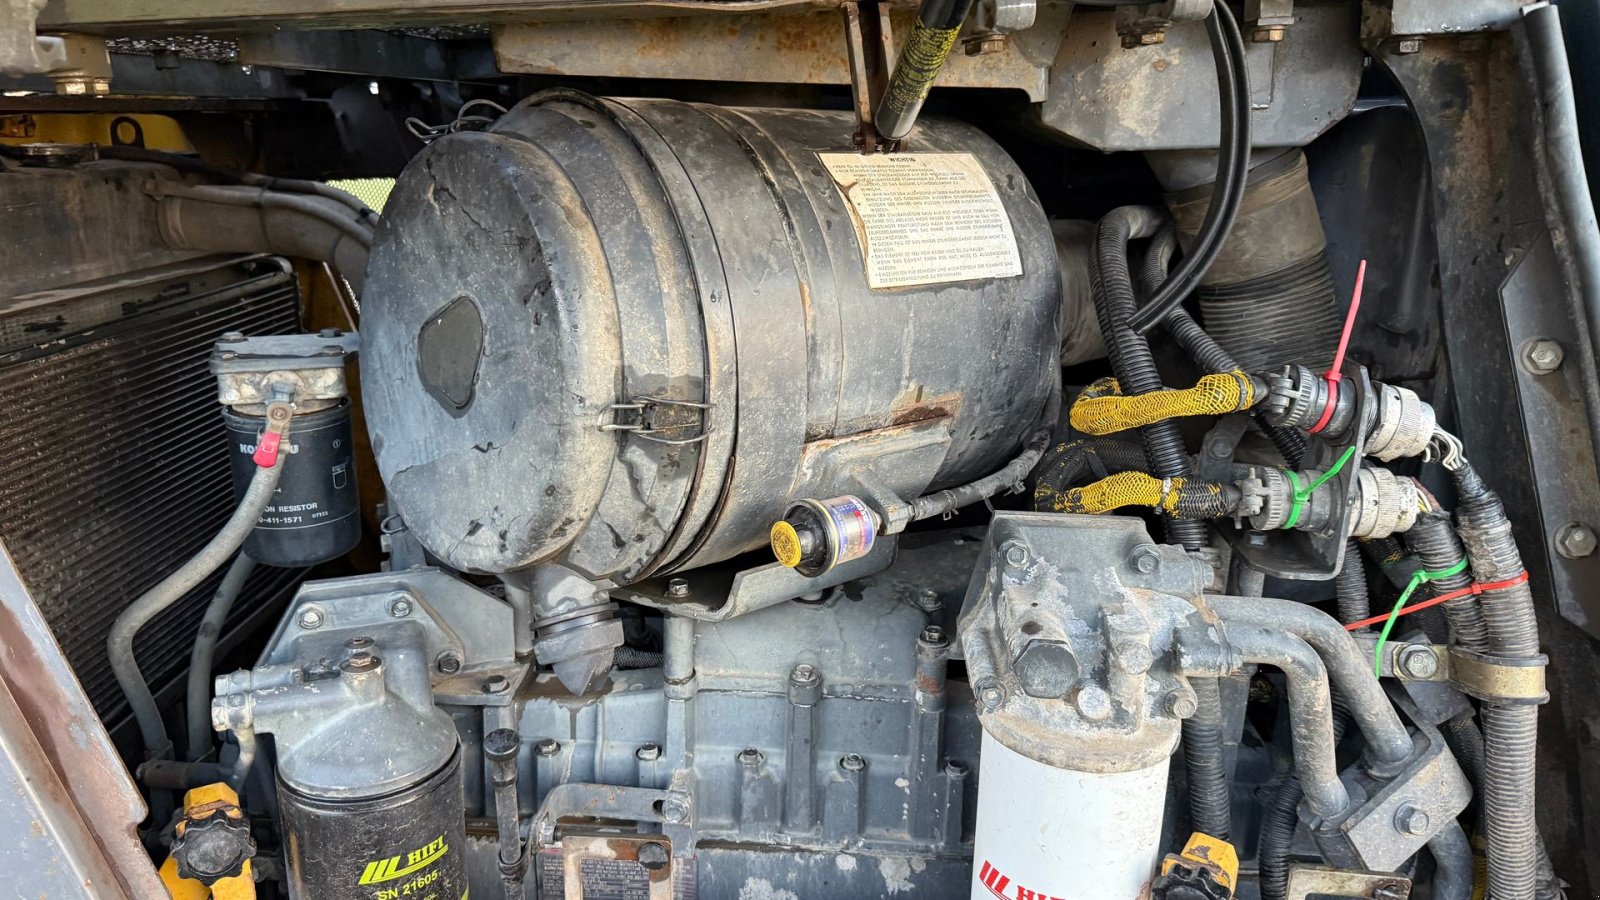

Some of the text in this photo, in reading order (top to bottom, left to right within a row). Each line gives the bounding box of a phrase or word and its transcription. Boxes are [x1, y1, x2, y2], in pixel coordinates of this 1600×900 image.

[278, 502, 318, 513] RESISTOR
[407, 835, 444, 865] HIFI
[377, 870, 438, 900] SN 21605
